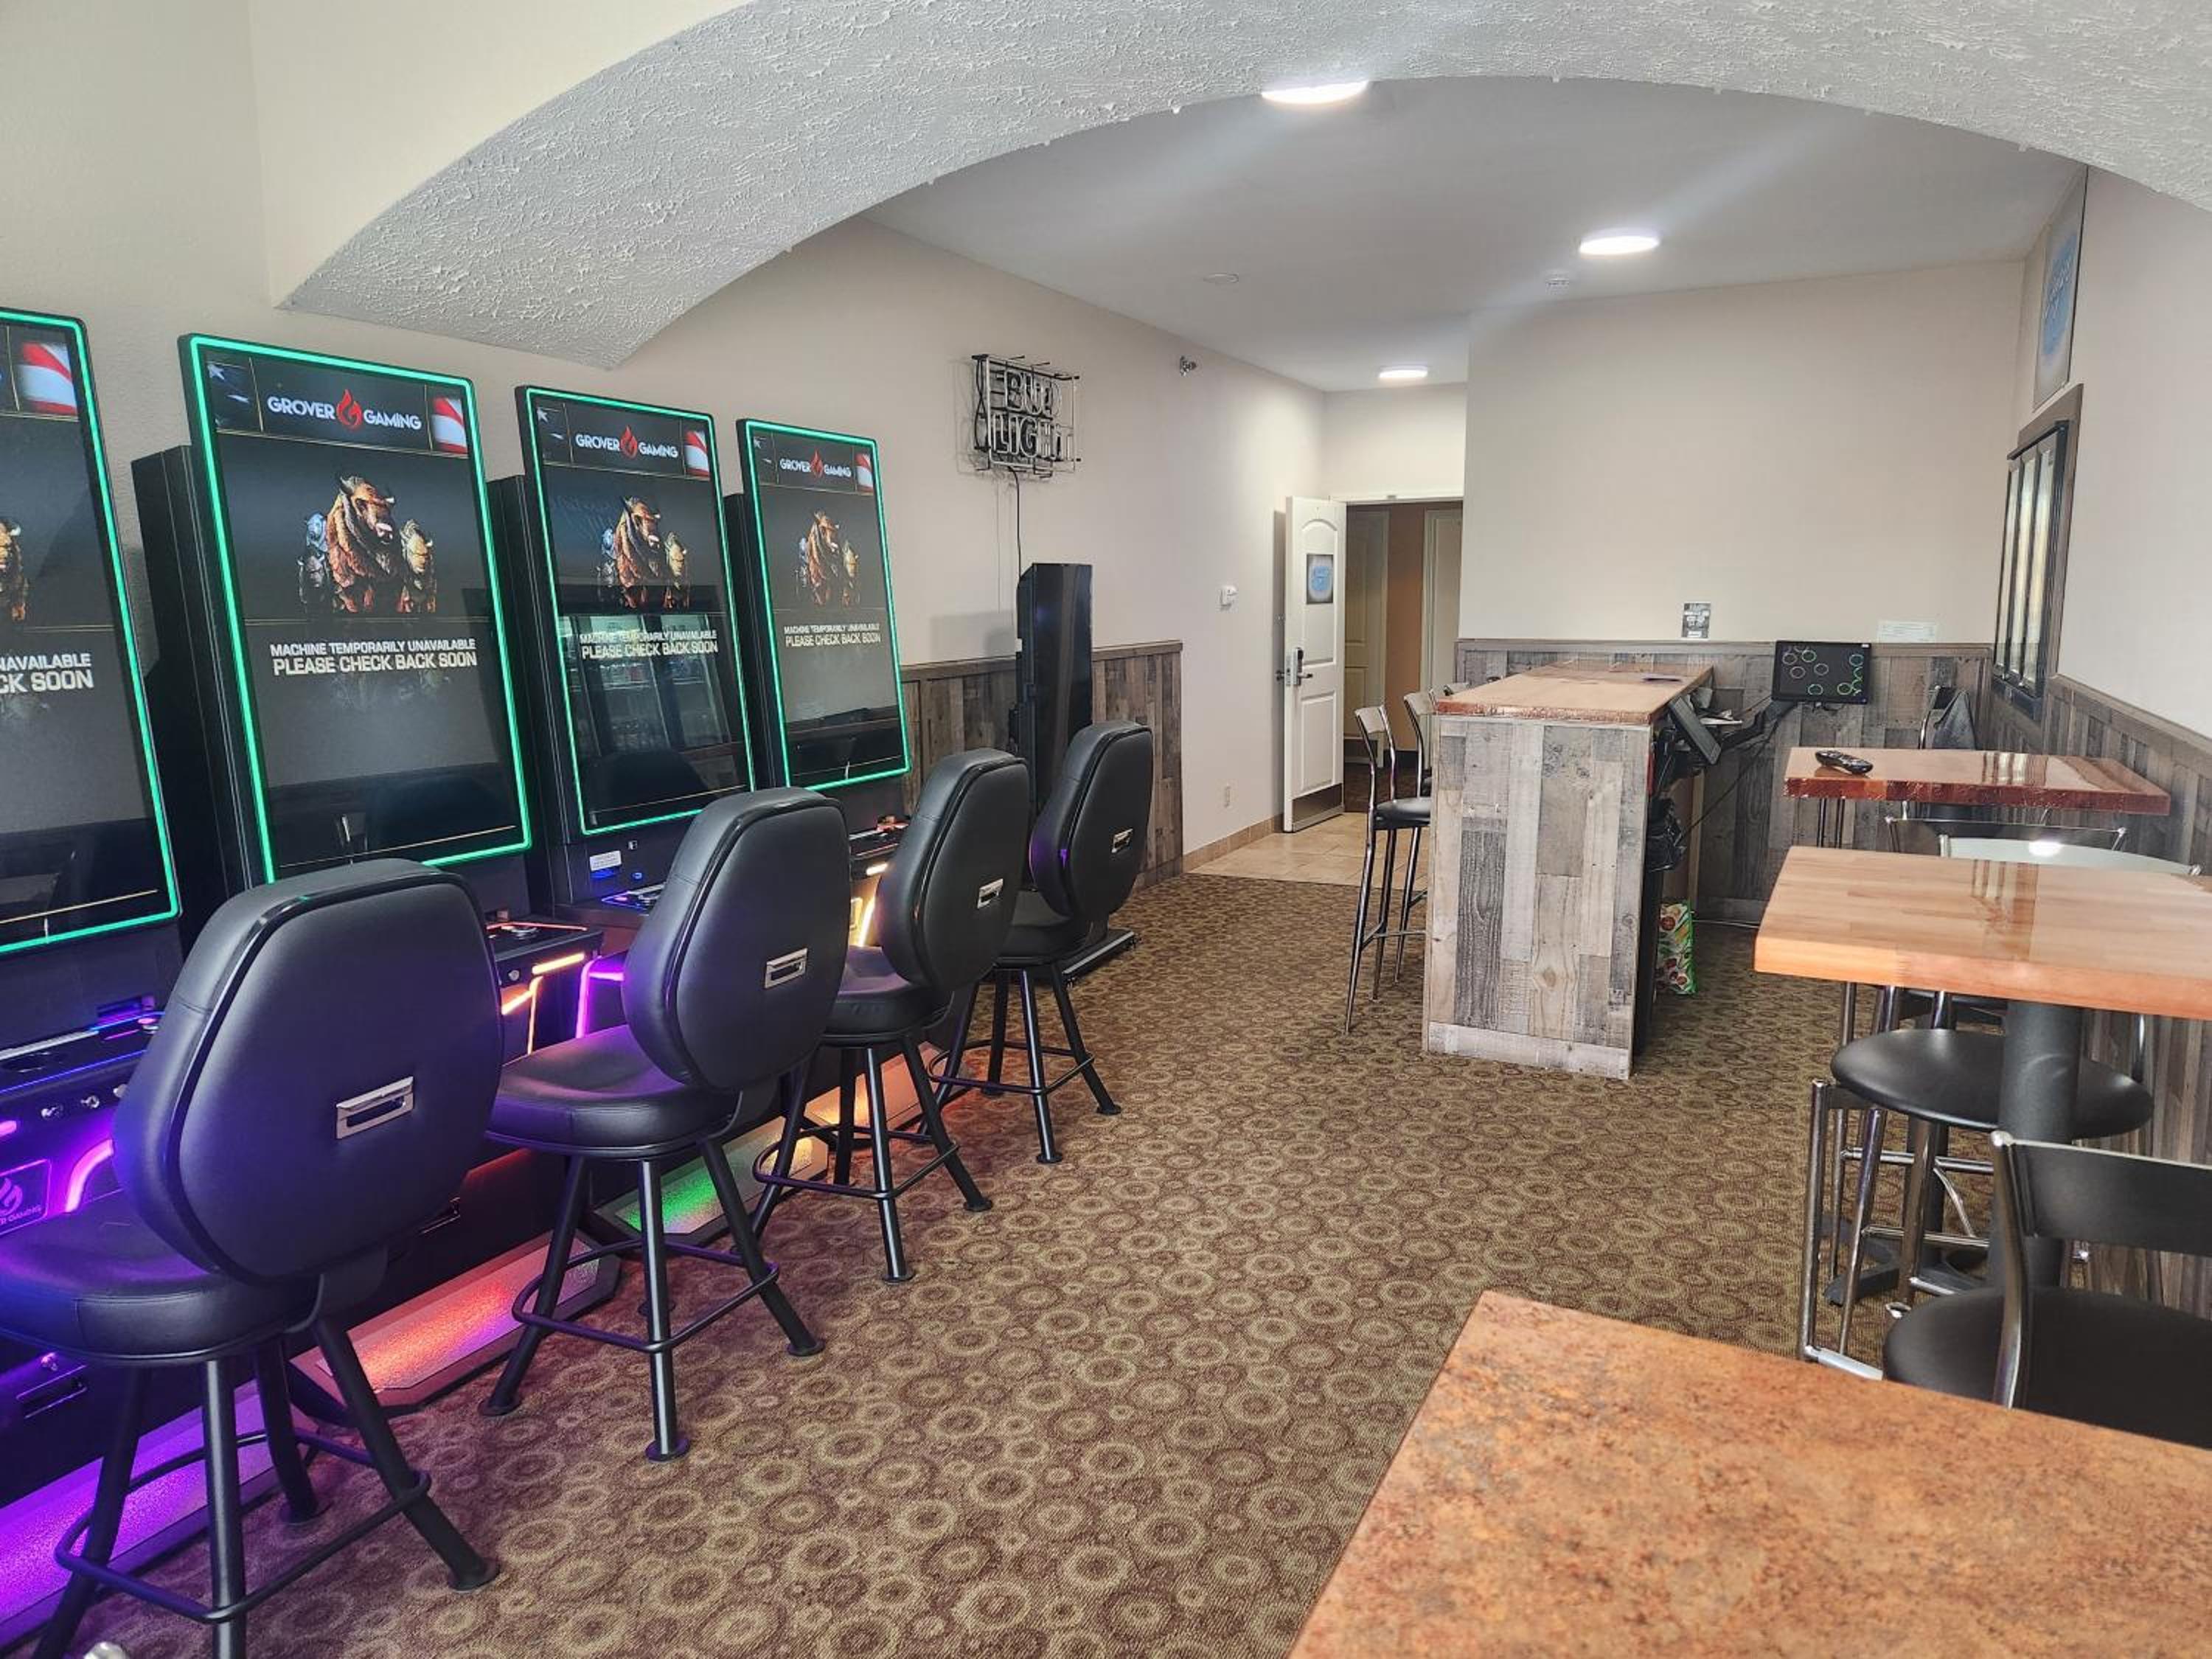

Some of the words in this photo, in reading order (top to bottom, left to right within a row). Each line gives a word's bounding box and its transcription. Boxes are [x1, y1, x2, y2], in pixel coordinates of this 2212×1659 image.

[267, 396, 335, 420] GROVER
[364, 409, 422, 430] GAMING
[575, 434, 620, 451] GROVER
[638, 442, 679, 458] GAMING
[779, 458, 811, 472] GROVER
[824, 464, 852, 477] GAMING
[669, 630, 717, 641] UNAVAILABLE
[785, 635, 815, 647] PLEASE
[815, 633, 841, 646] CHECK
[841, 633, 862, 644] BACK
[862, 632, 881, 643] SOON
[270, 643, 327, 657] MACHINE
[329, 641, 405, 655] TEMPORARILY
[407, 639, 476, 652] UNAVAILABLE
[581, 644, 623, 659] PLEASE
[625, 642, 661, 657] CHECK
[661, 641, 689, 655] BACK
[691, 640, 719, 653] SOON
[273, 656, 336, 676] PLEASE
[339, 655, 393, 672] CHECK
[395, 653, 436, 670] BACK
[438, 652, 478, 667] SOON
[30, 669, 94, 692] SOON
